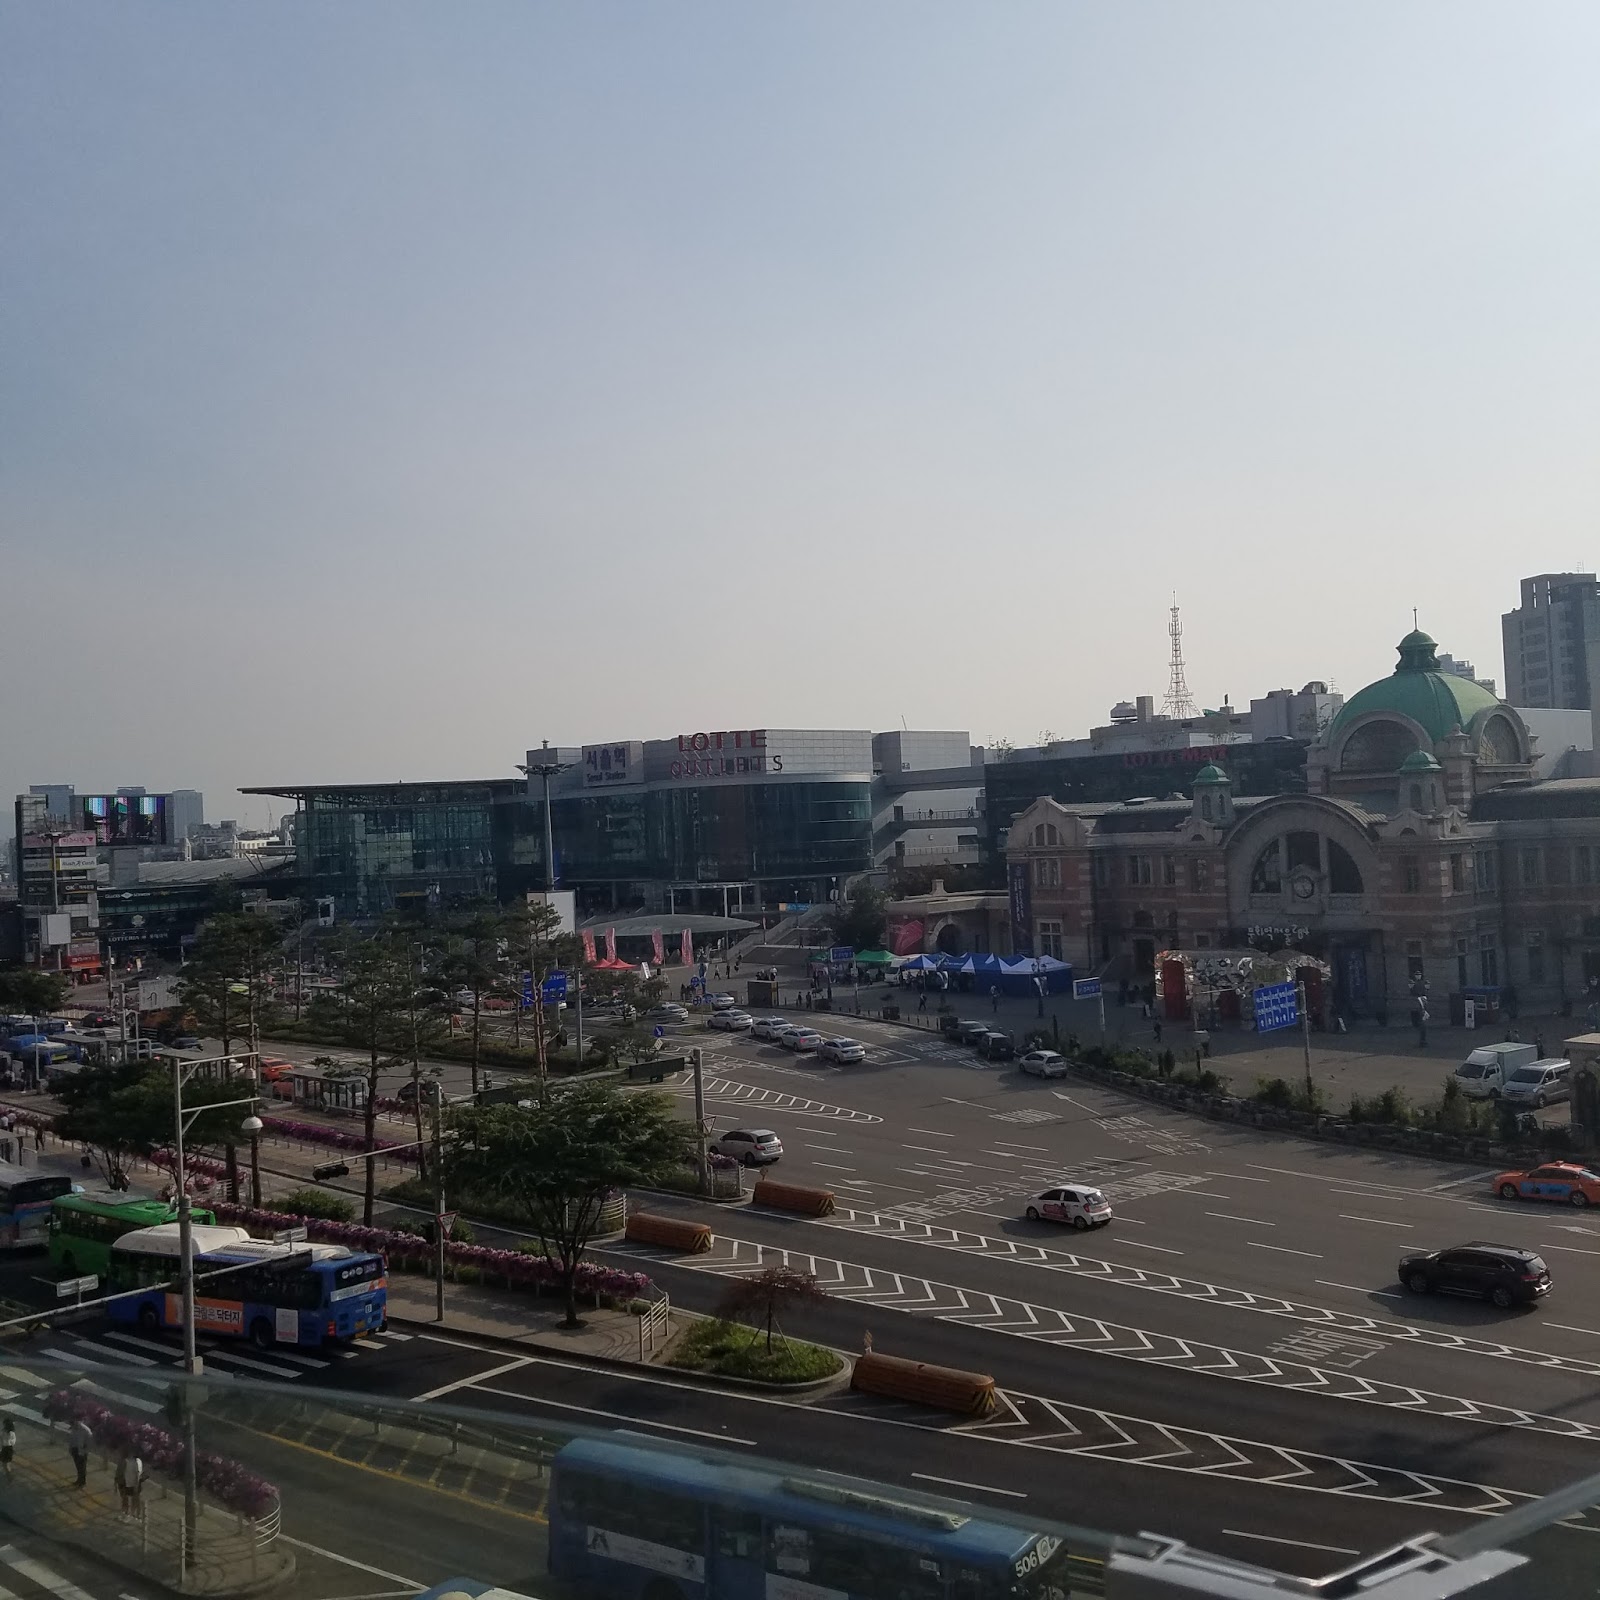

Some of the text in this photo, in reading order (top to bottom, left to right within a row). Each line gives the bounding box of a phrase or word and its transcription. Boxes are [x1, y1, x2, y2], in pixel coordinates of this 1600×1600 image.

[679, 730, 767, 752] LOTTE
[587, 747, 626, 771] 서울역
[671, 755, 783, 778] OUTLETS
[587, 771, 626, 783] Seoul Station
[217, 1308, 240, 1324] 닥터지
[1265, 1326, 1393, 1369] 천천히
[1015, 1550, 1038, 1578] 506
